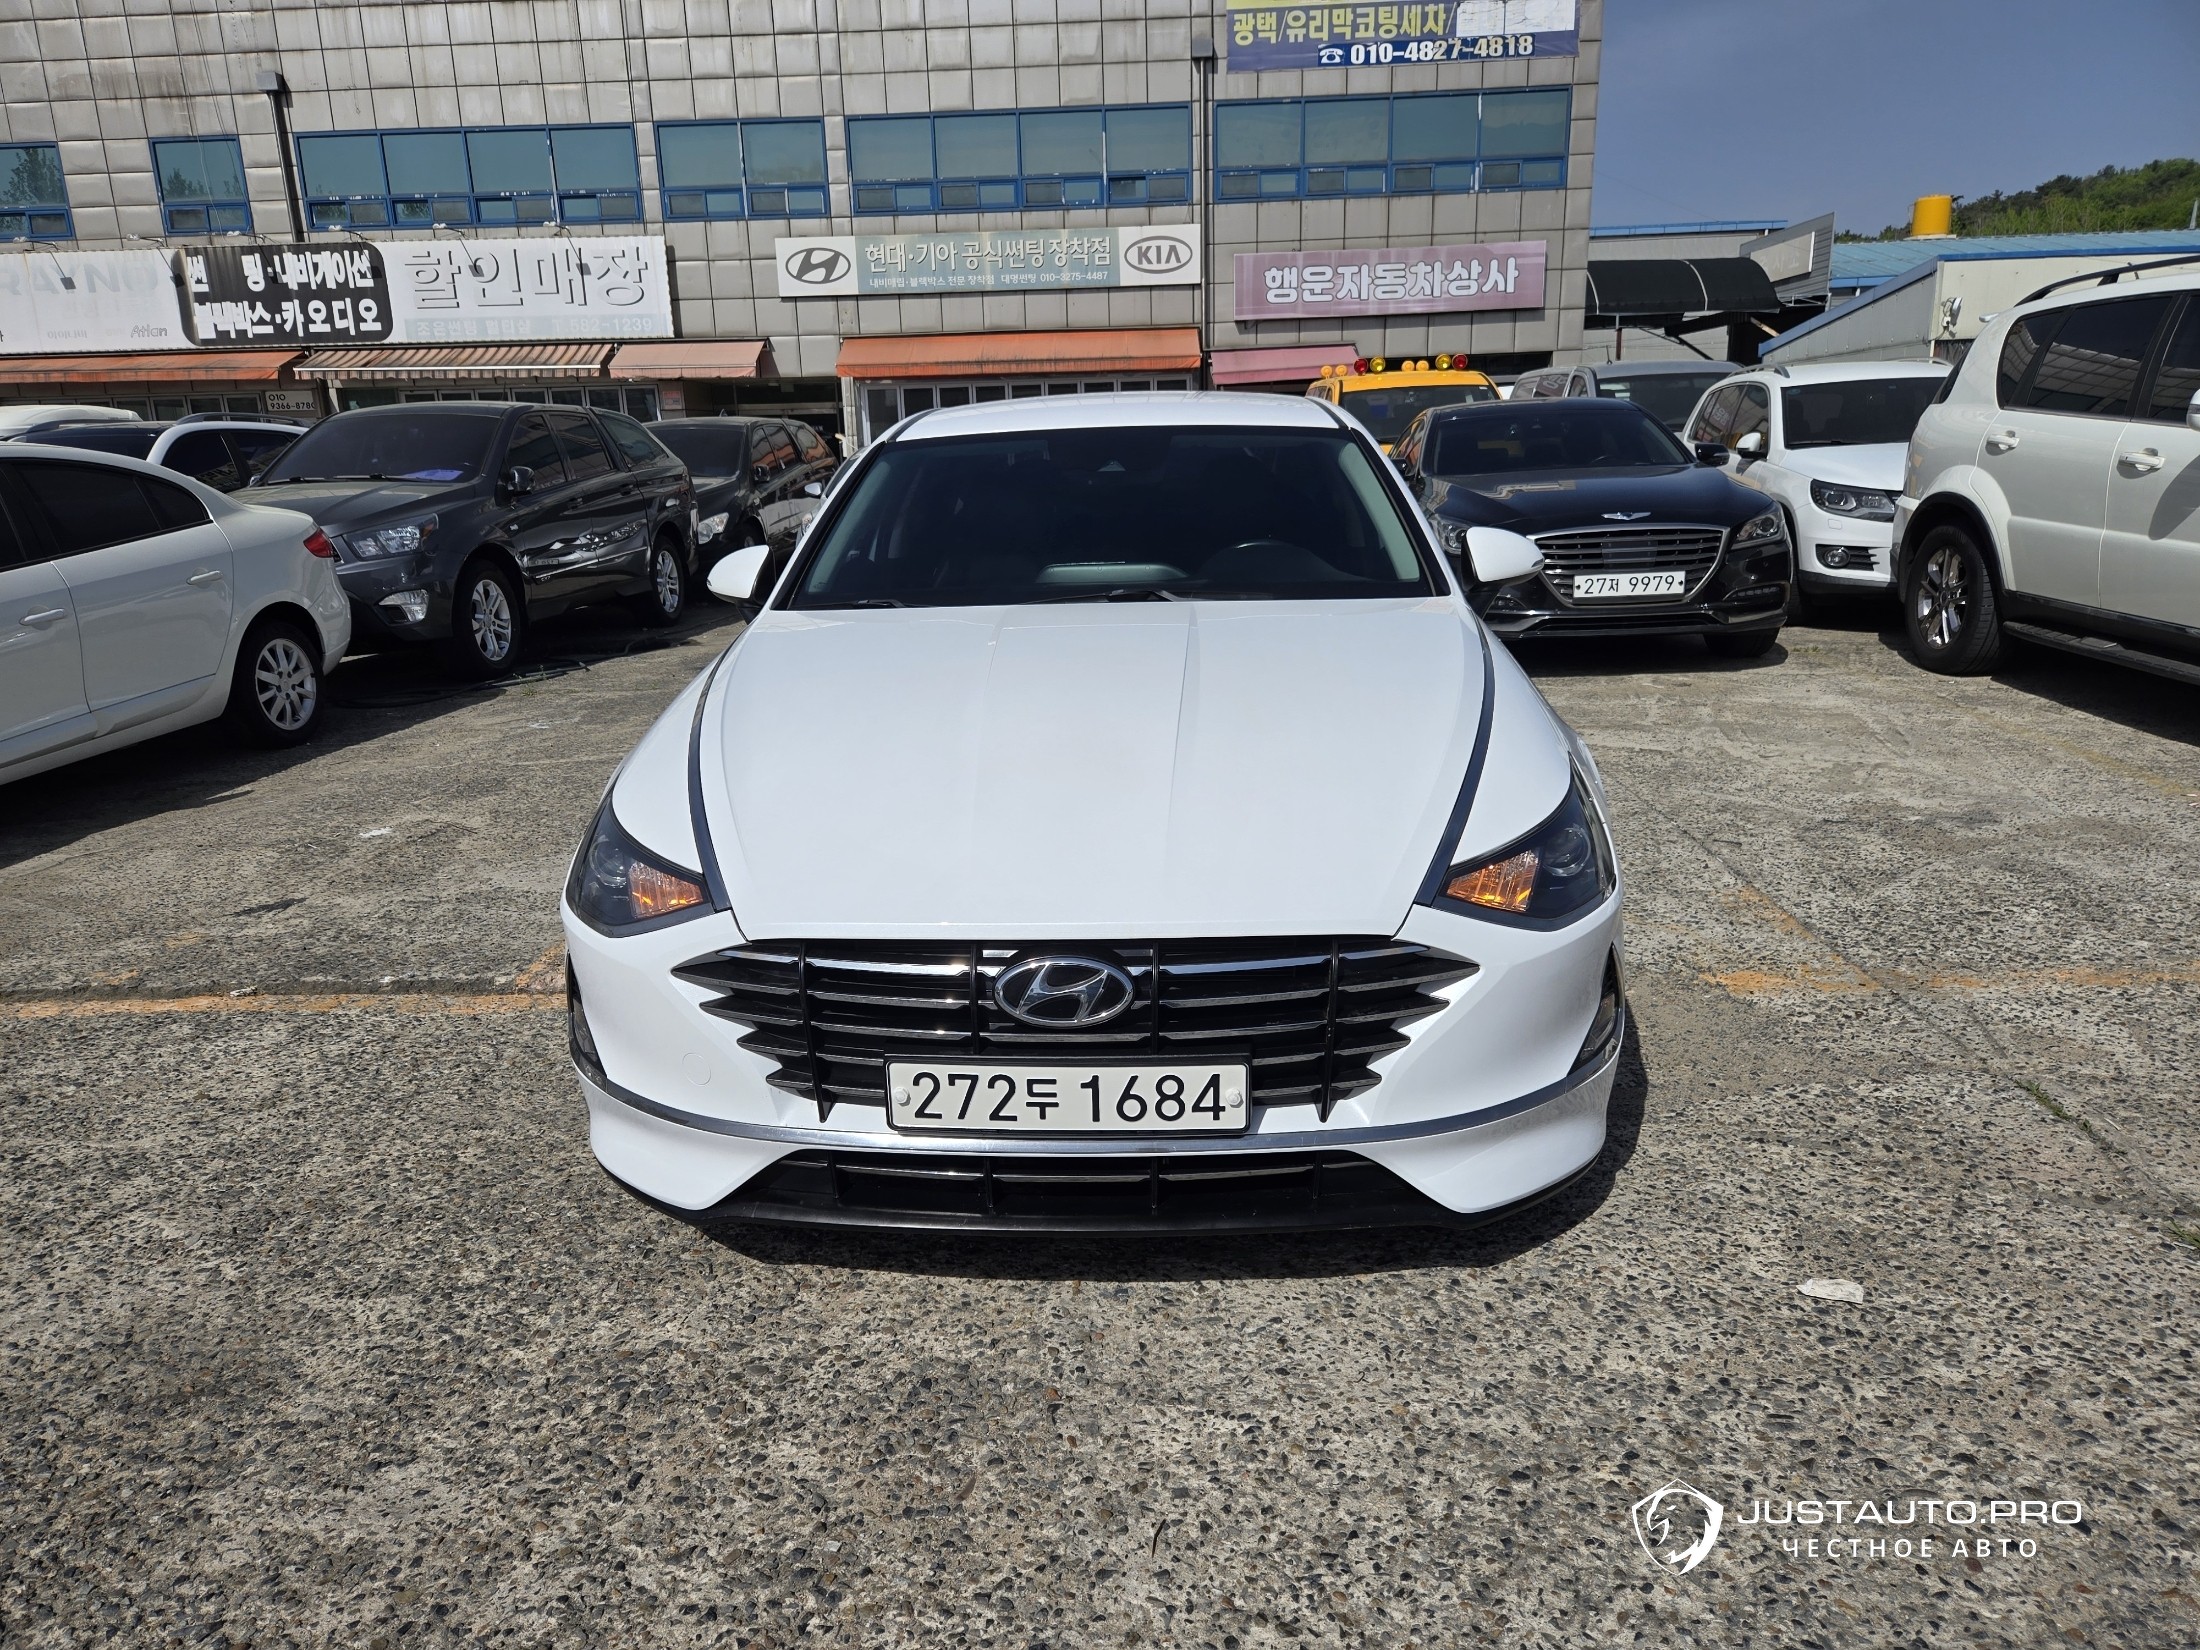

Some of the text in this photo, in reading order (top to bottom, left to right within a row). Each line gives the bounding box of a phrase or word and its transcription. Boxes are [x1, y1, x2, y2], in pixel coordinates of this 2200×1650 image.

[1350, 35, 1533, 65] 010-4827-4818
[962, 239, 1045, 269] 공식썬팅
[1049, 236, 1112, 267] 장착점
[1136, 243, 1181, 265] KIA
[405, 247, 649, 309] 할인매장
[948, 276, 966, 286] 전문
[968, 274, 995, 286] 장착점
[1040, 271, 1108, 282] 010-3275-4487
[1263, 256, 1520, 304] 행운자동차상사
[552, 317, 652, 334] T.582-1239
[1584, 575, 1675, 594] 27저 9979
[912, 1071, 1226, 1122] 272두 1684
